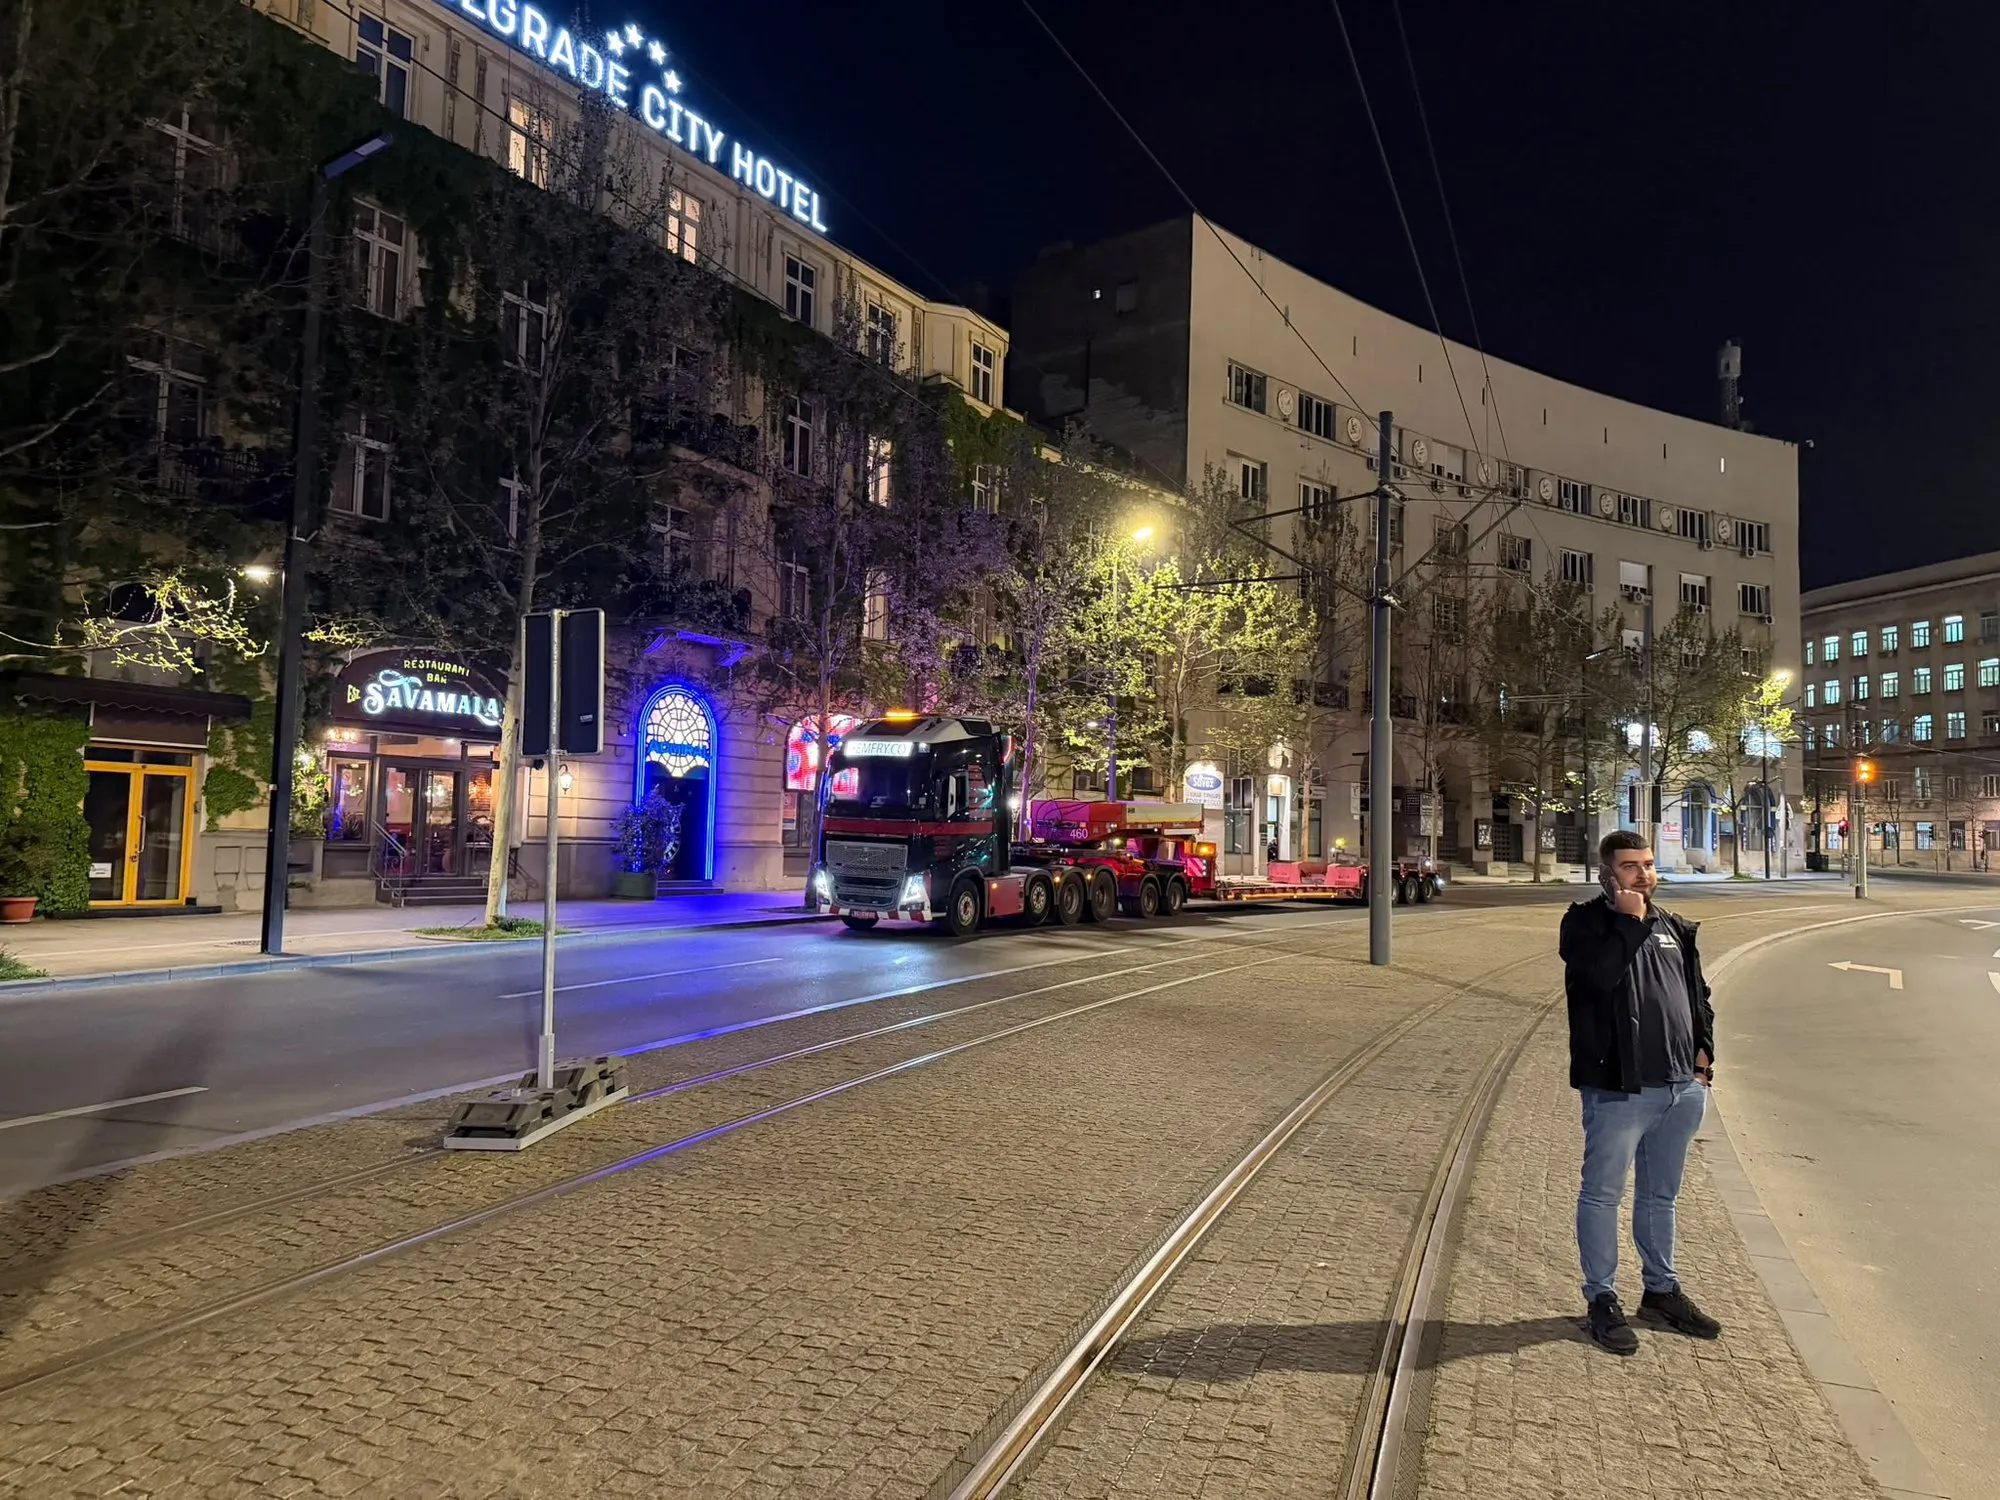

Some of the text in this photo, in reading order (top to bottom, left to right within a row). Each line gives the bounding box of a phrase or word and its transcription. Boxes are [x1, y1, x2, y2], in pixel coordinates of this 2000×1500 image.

[642, 86, 725, 164] CITY
[732, 141, 828, 233] HOTEL
[364, 669, 502, 726] SAVAMALA
[1069, 828, 1089, 839] 460
